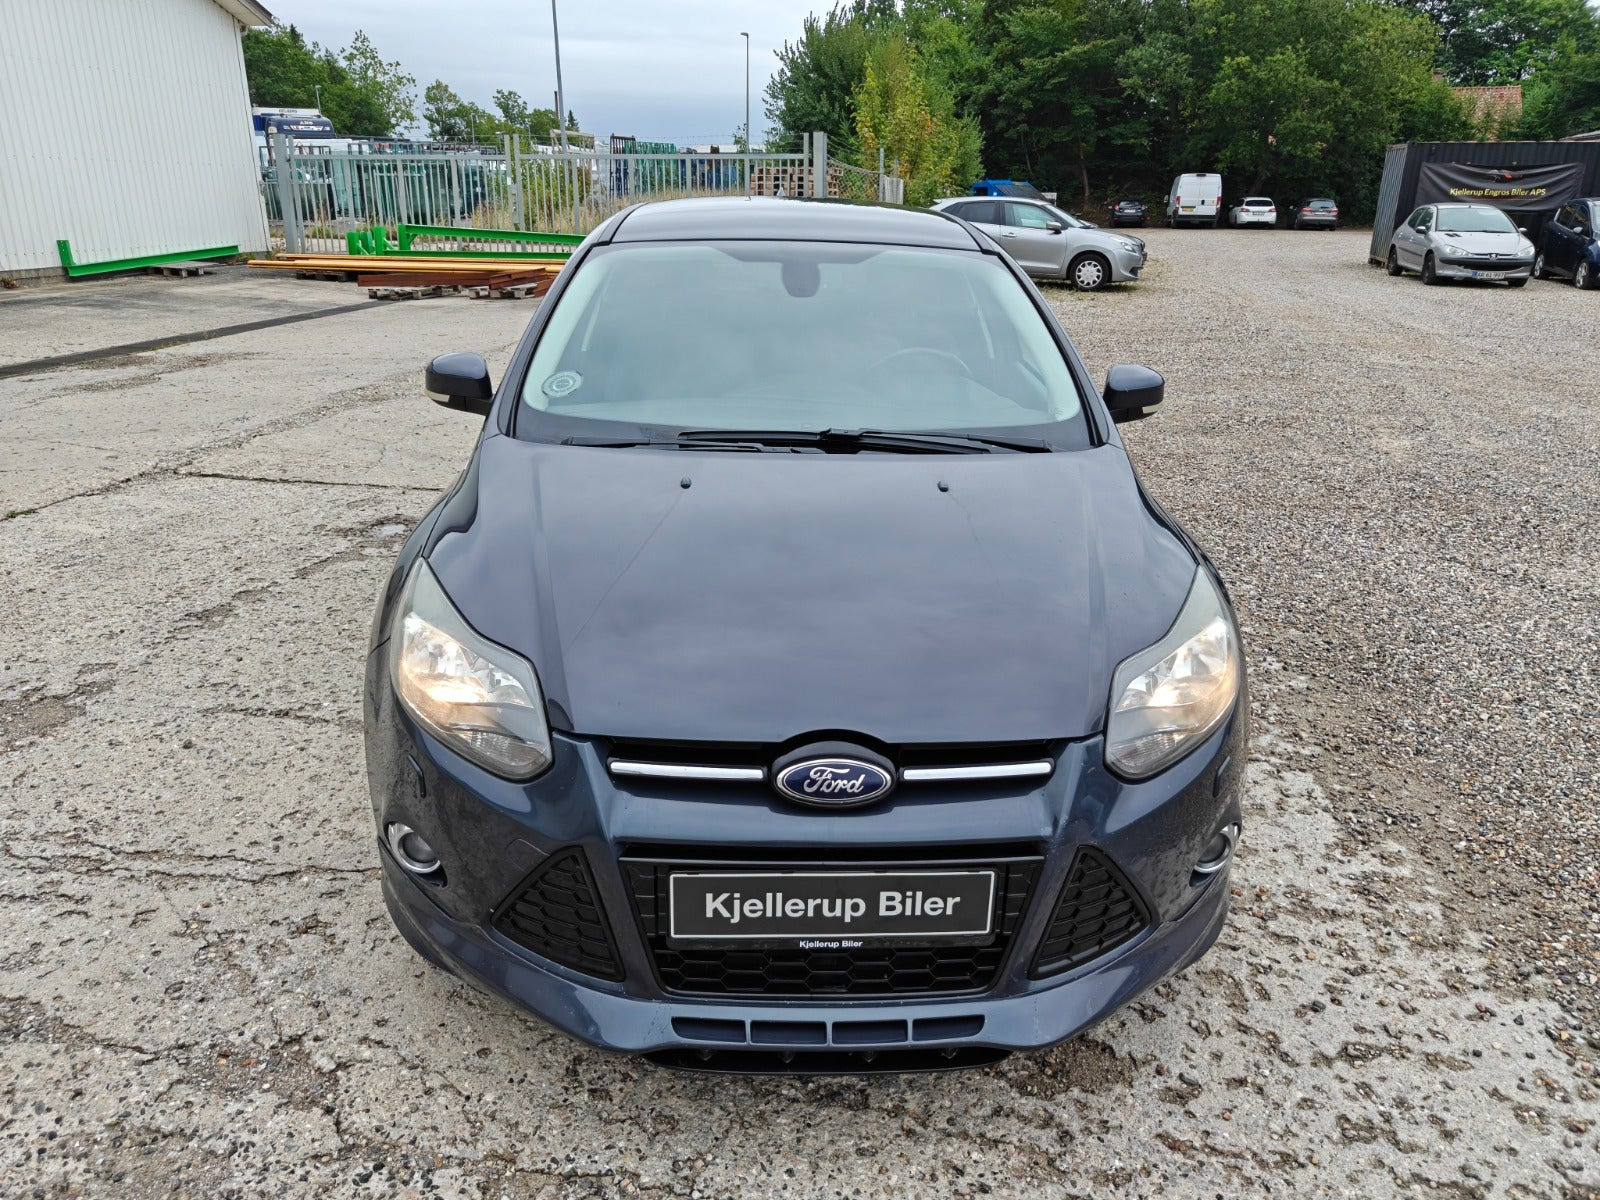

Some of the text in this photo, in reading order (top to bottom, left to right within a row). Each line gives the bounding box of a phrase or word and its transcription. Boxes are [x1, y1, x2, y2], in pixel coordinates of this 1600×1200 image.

[1450, 187, 1546, 197] Kjellerup Engros Biler APS
[803, 766, 866, 793] Ford
[705, 890, 961, 924] Kjellerup Biler
[799, 940, 864, 949] Kjellerup Biler
